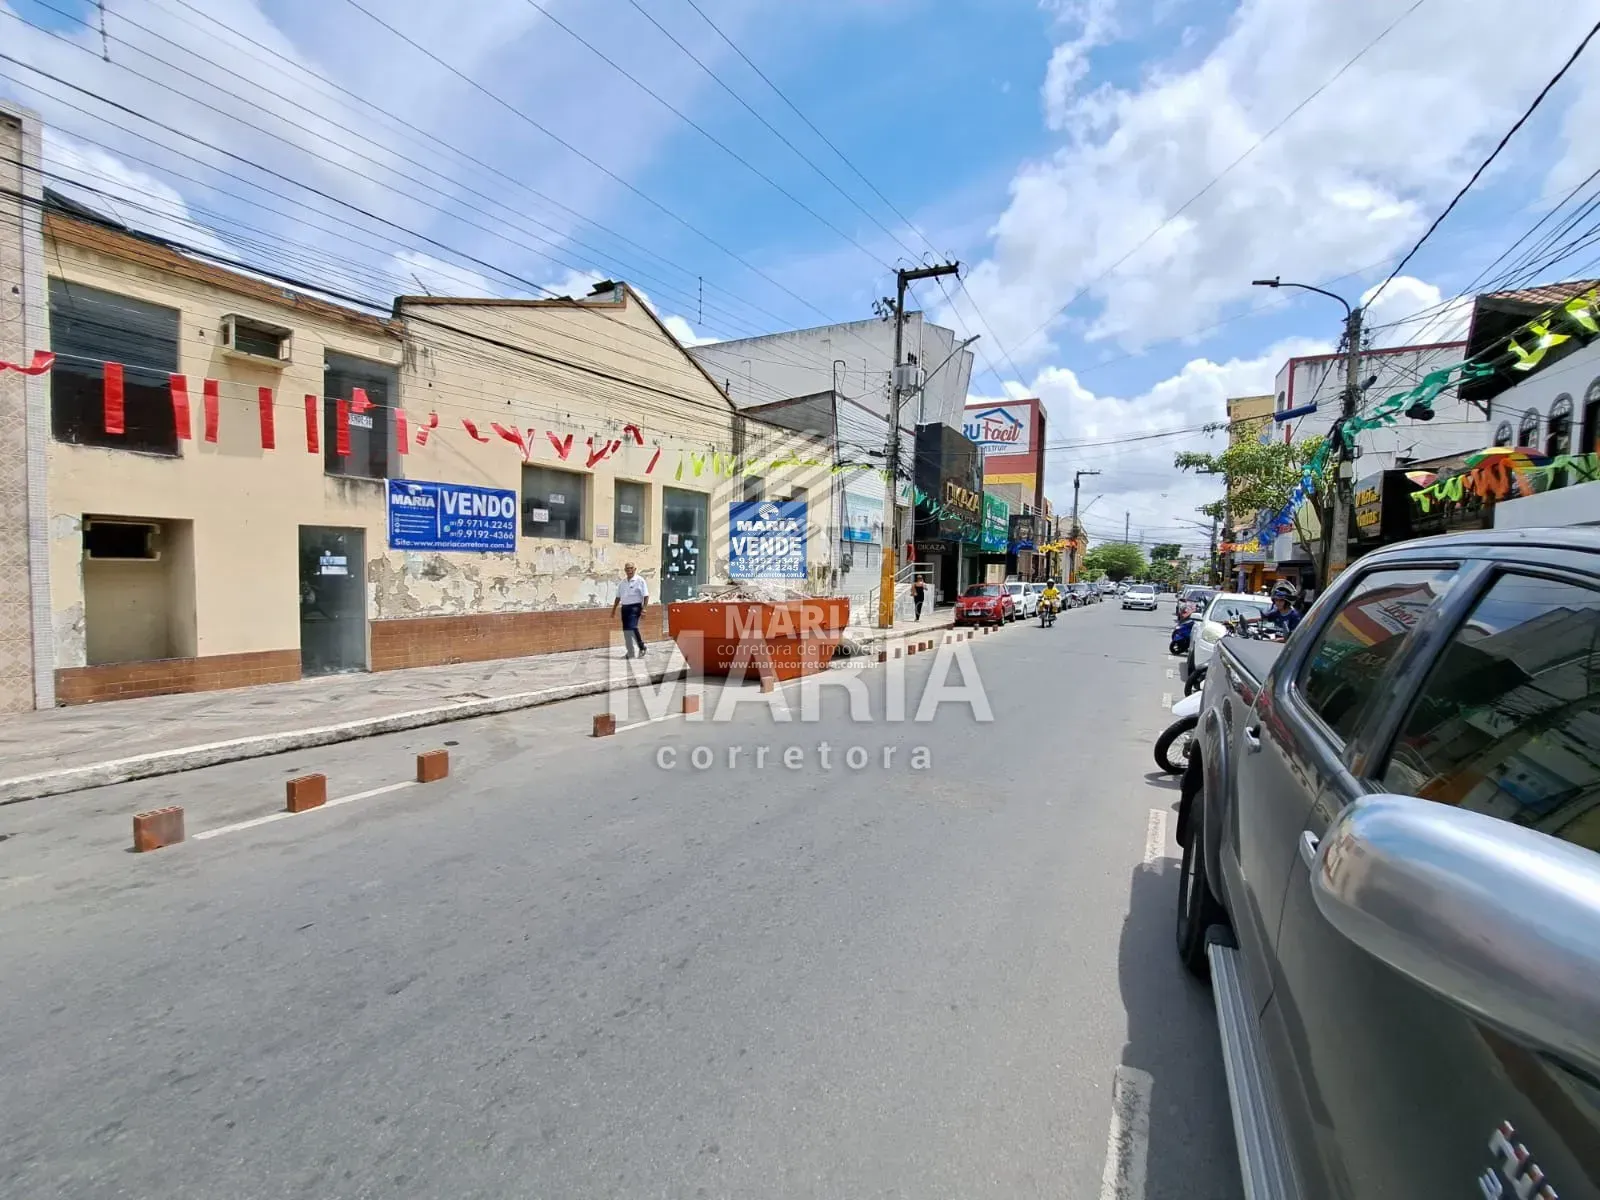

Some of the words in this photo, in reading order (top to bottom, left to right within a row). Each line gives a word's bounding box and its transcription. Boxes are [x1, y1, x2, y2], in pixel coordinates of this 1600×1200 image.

[391, 494, 435, 508] MARIA
[443, 490, 514, 519] VENDO
[732, 537, 802, 556] VENDE
